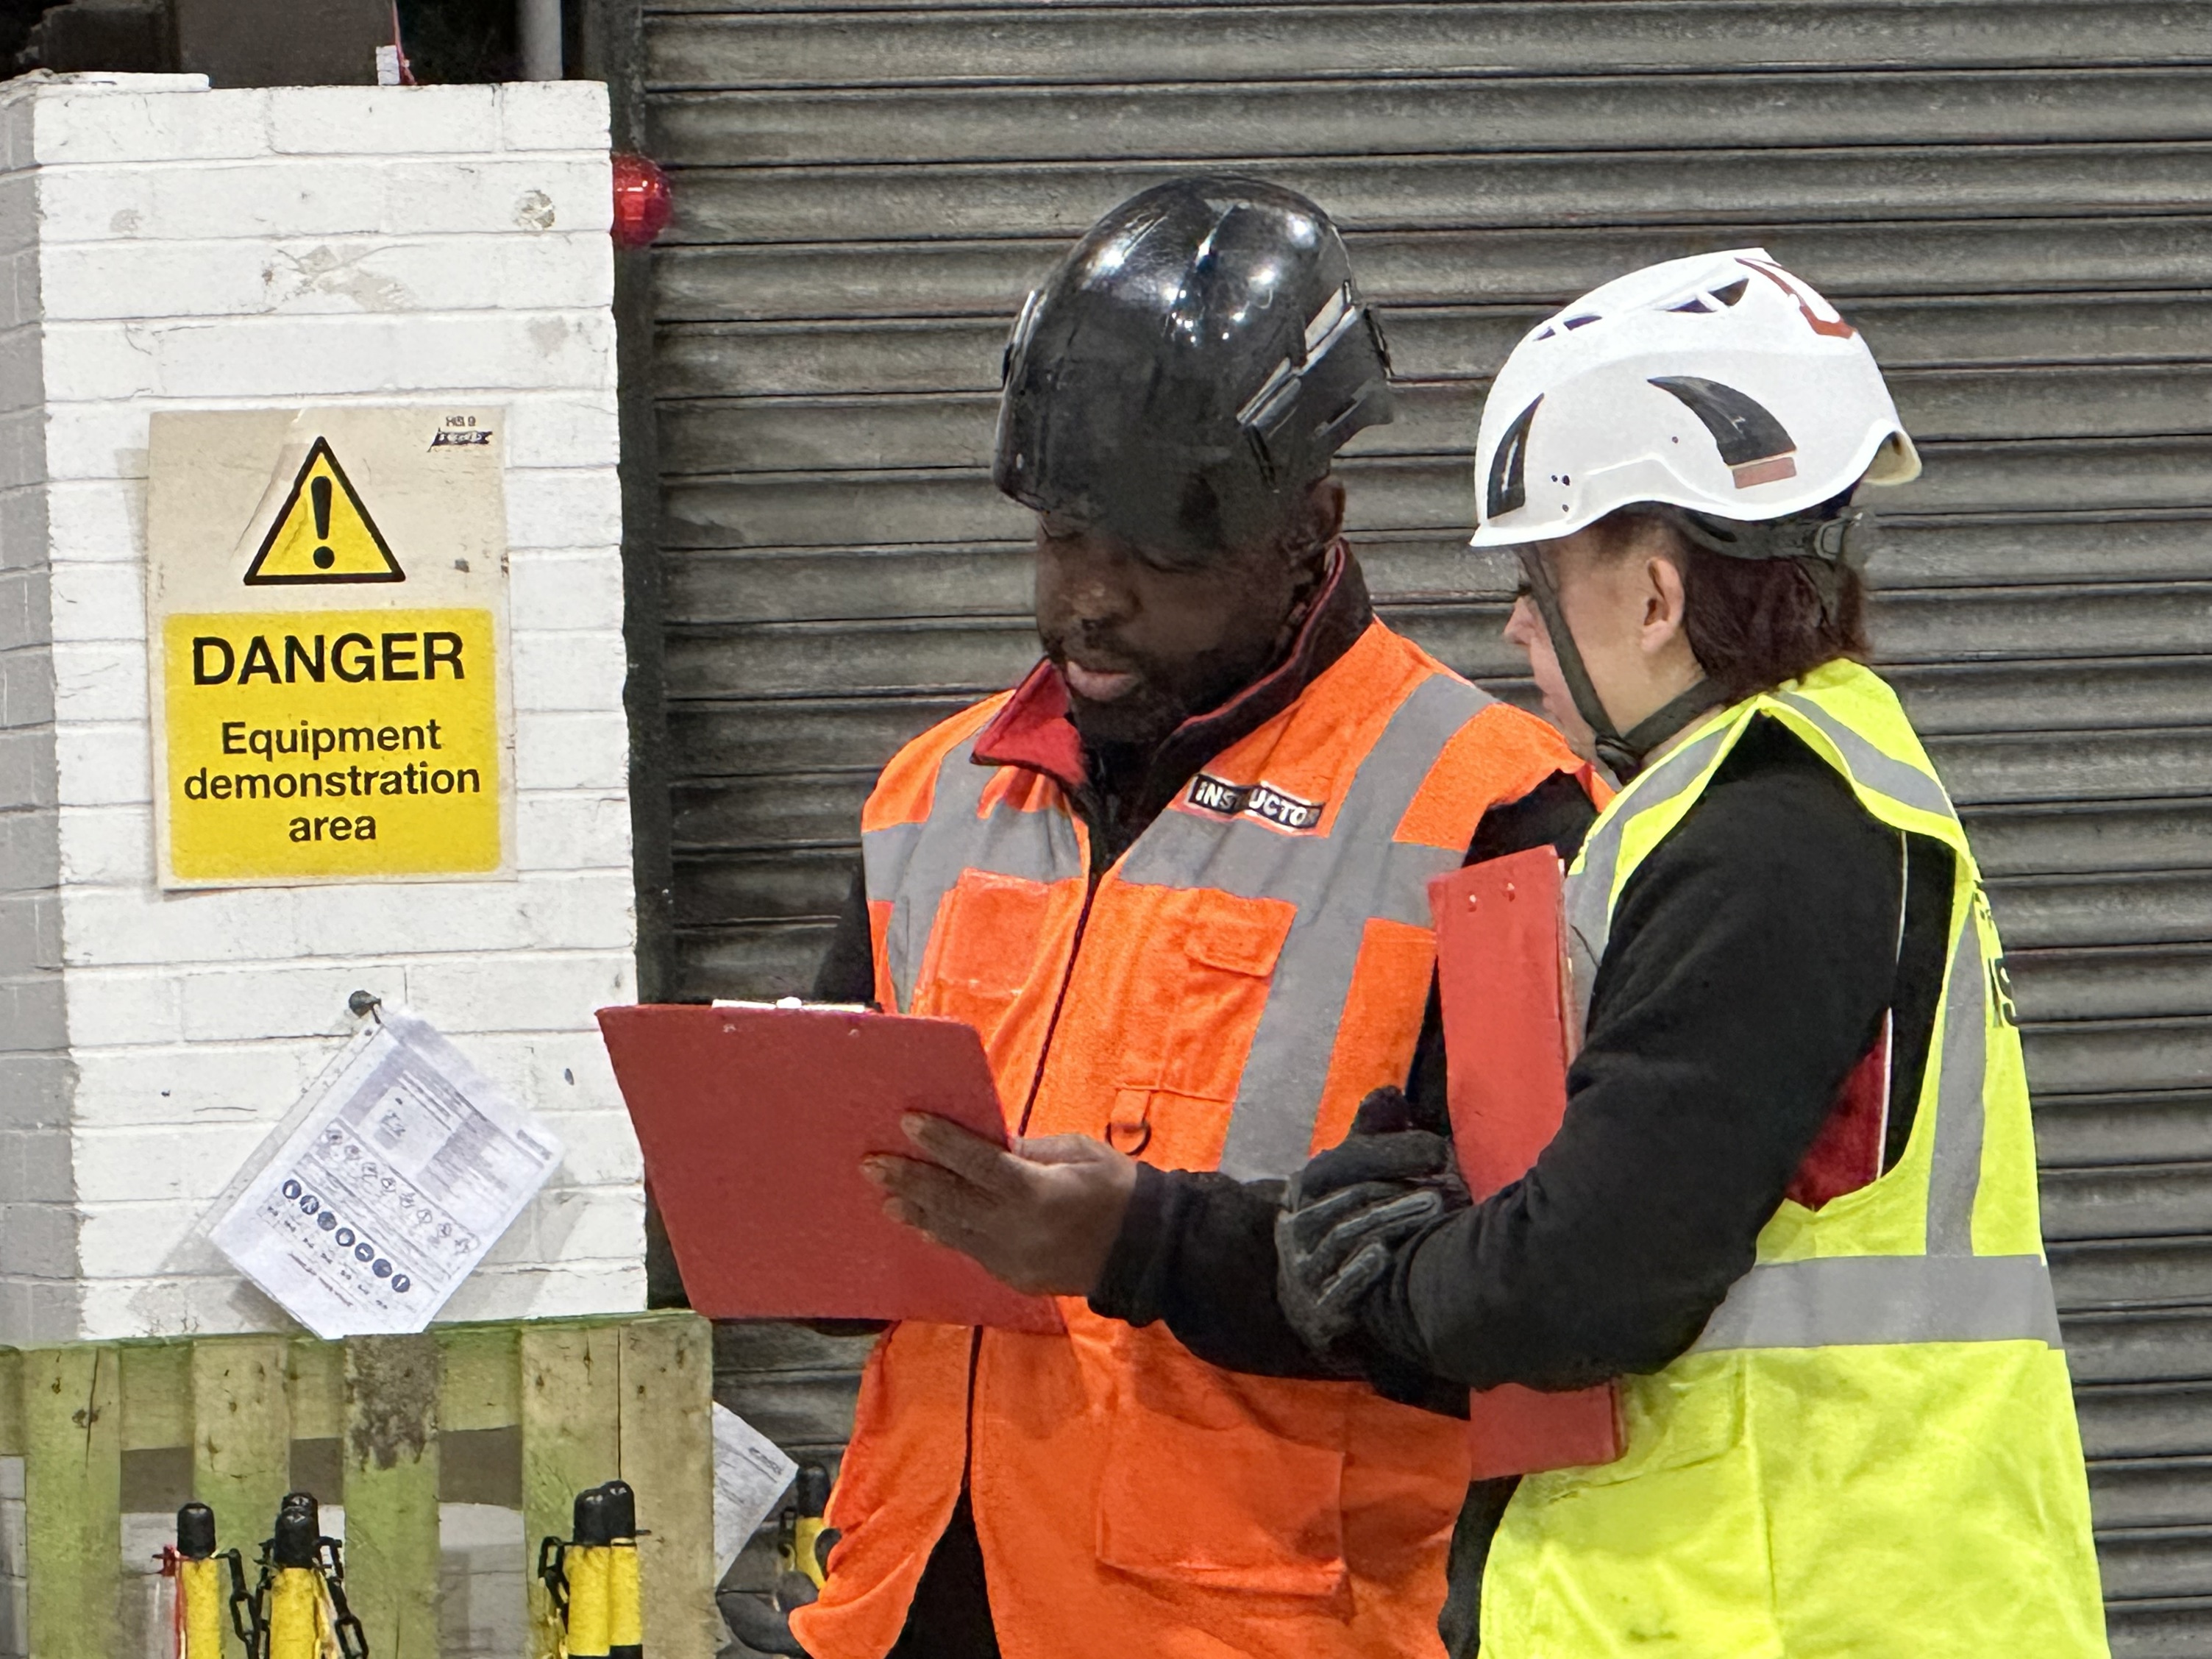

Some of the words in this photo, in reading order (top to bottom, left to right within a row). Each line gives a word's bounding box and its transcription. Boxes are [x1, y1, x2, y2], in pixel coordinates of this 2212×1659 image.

[193, 631, 464, 686] DANGER
[222, 719, 441, 761] Equipment
[185, 761, 480, 800] demonstration
[1195, 780, 1318, 826] INSUCTO
[289, 816, 376, 842] area
